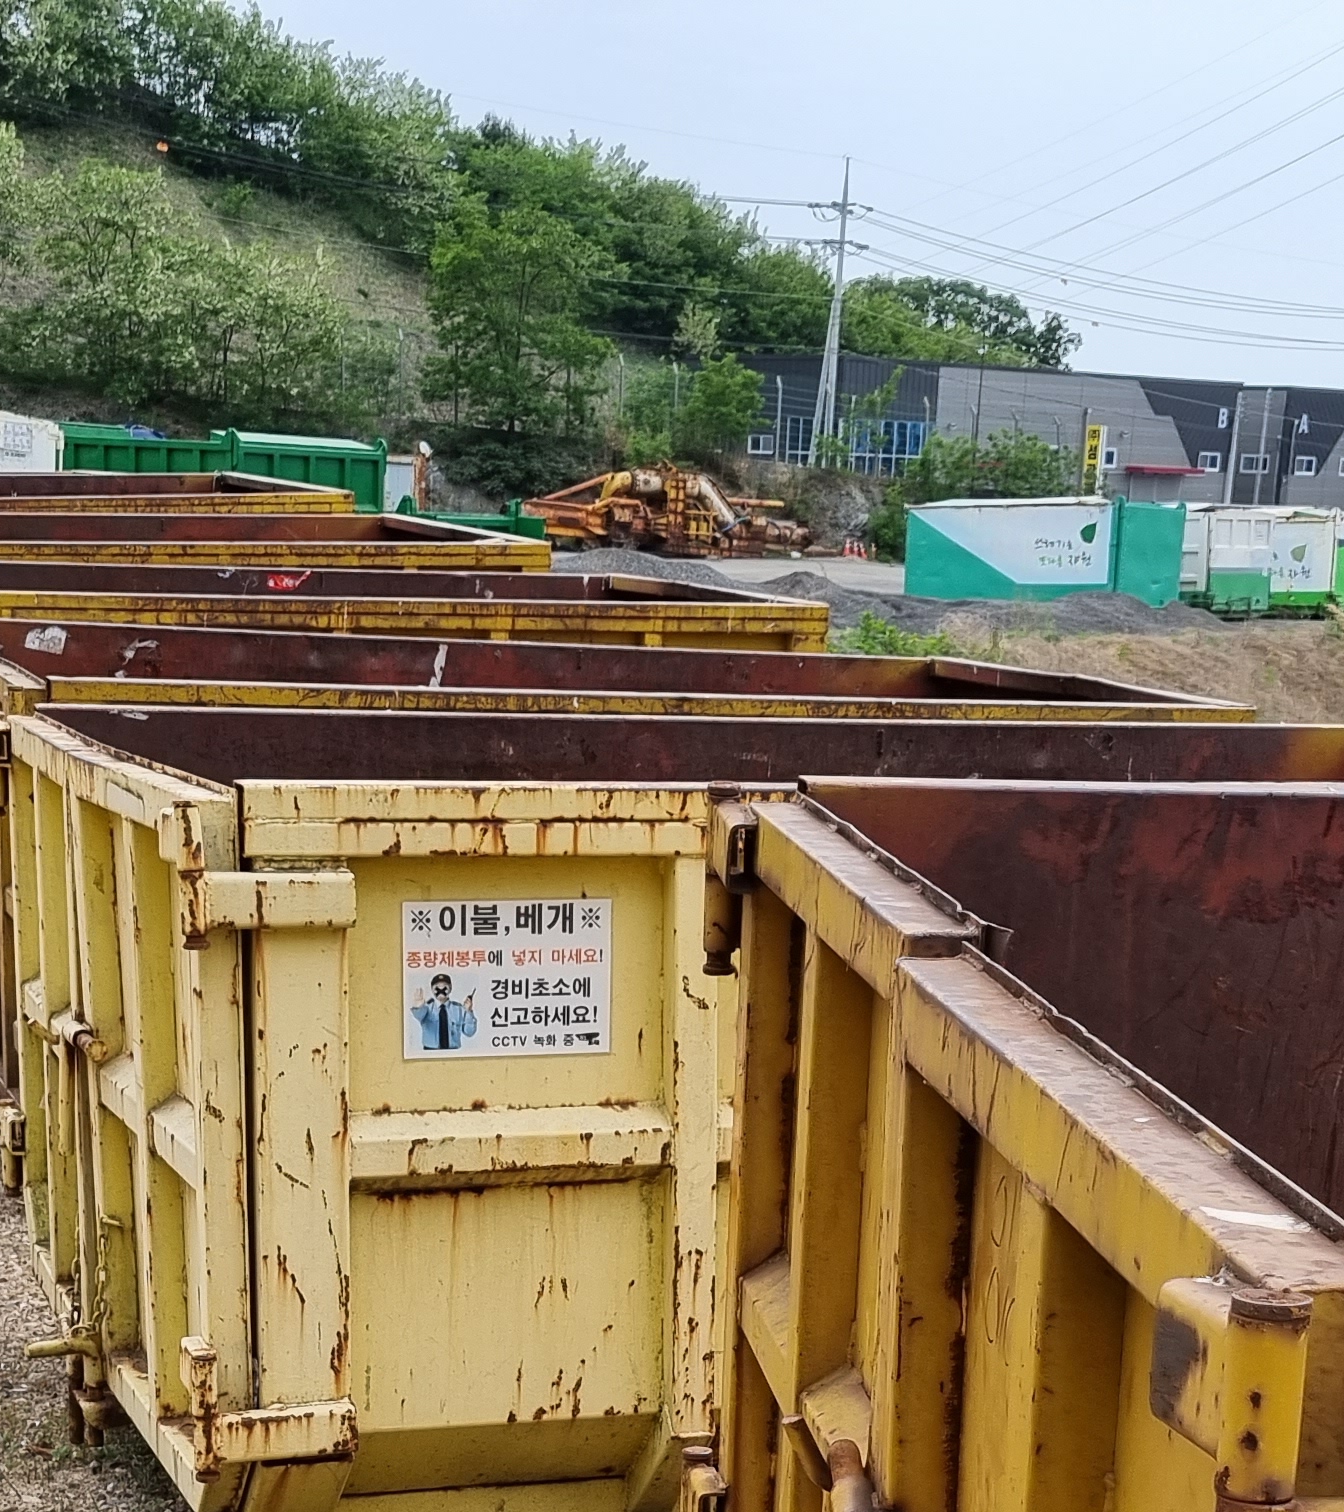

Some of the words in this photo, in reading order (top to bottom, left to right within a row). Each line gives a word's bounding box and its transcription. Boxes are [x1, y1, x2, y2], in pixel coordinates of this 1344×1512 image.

[1217, 407, 1230, 429] B
[1298, 413, 1309, 434] A
[406, 949, 503, 968] 종량제봉투에
[511, 949, 543, 966] 넣지
[551, 948, 604, 965] 마세요!
[490, 976, 591, 1000] 경비초소에
[490, 1005, 599, 1028] 신고하세요!
[491, 1035, 527, 1048] CCTV
[532, 1034, 557, 1048] 녹화
